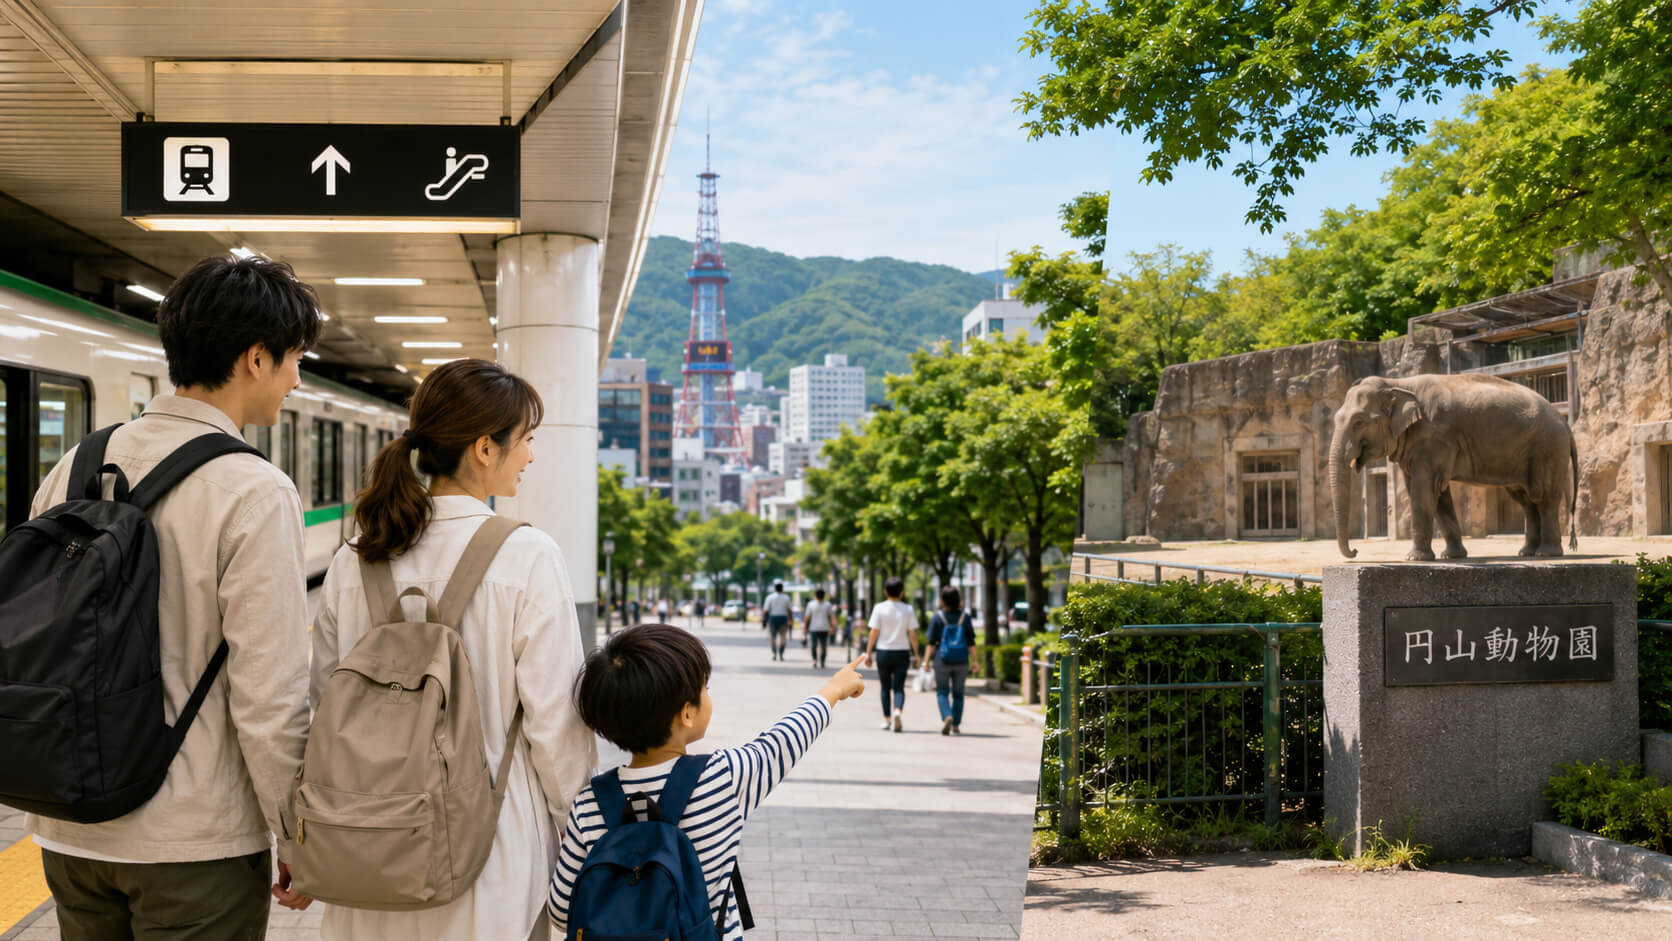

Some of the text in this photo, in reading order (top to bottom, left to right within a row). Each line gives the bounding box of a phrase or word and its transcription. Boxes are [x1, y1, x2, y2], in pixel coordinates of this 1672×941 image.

[1405, 625, 1597, 664] 円山動物園
